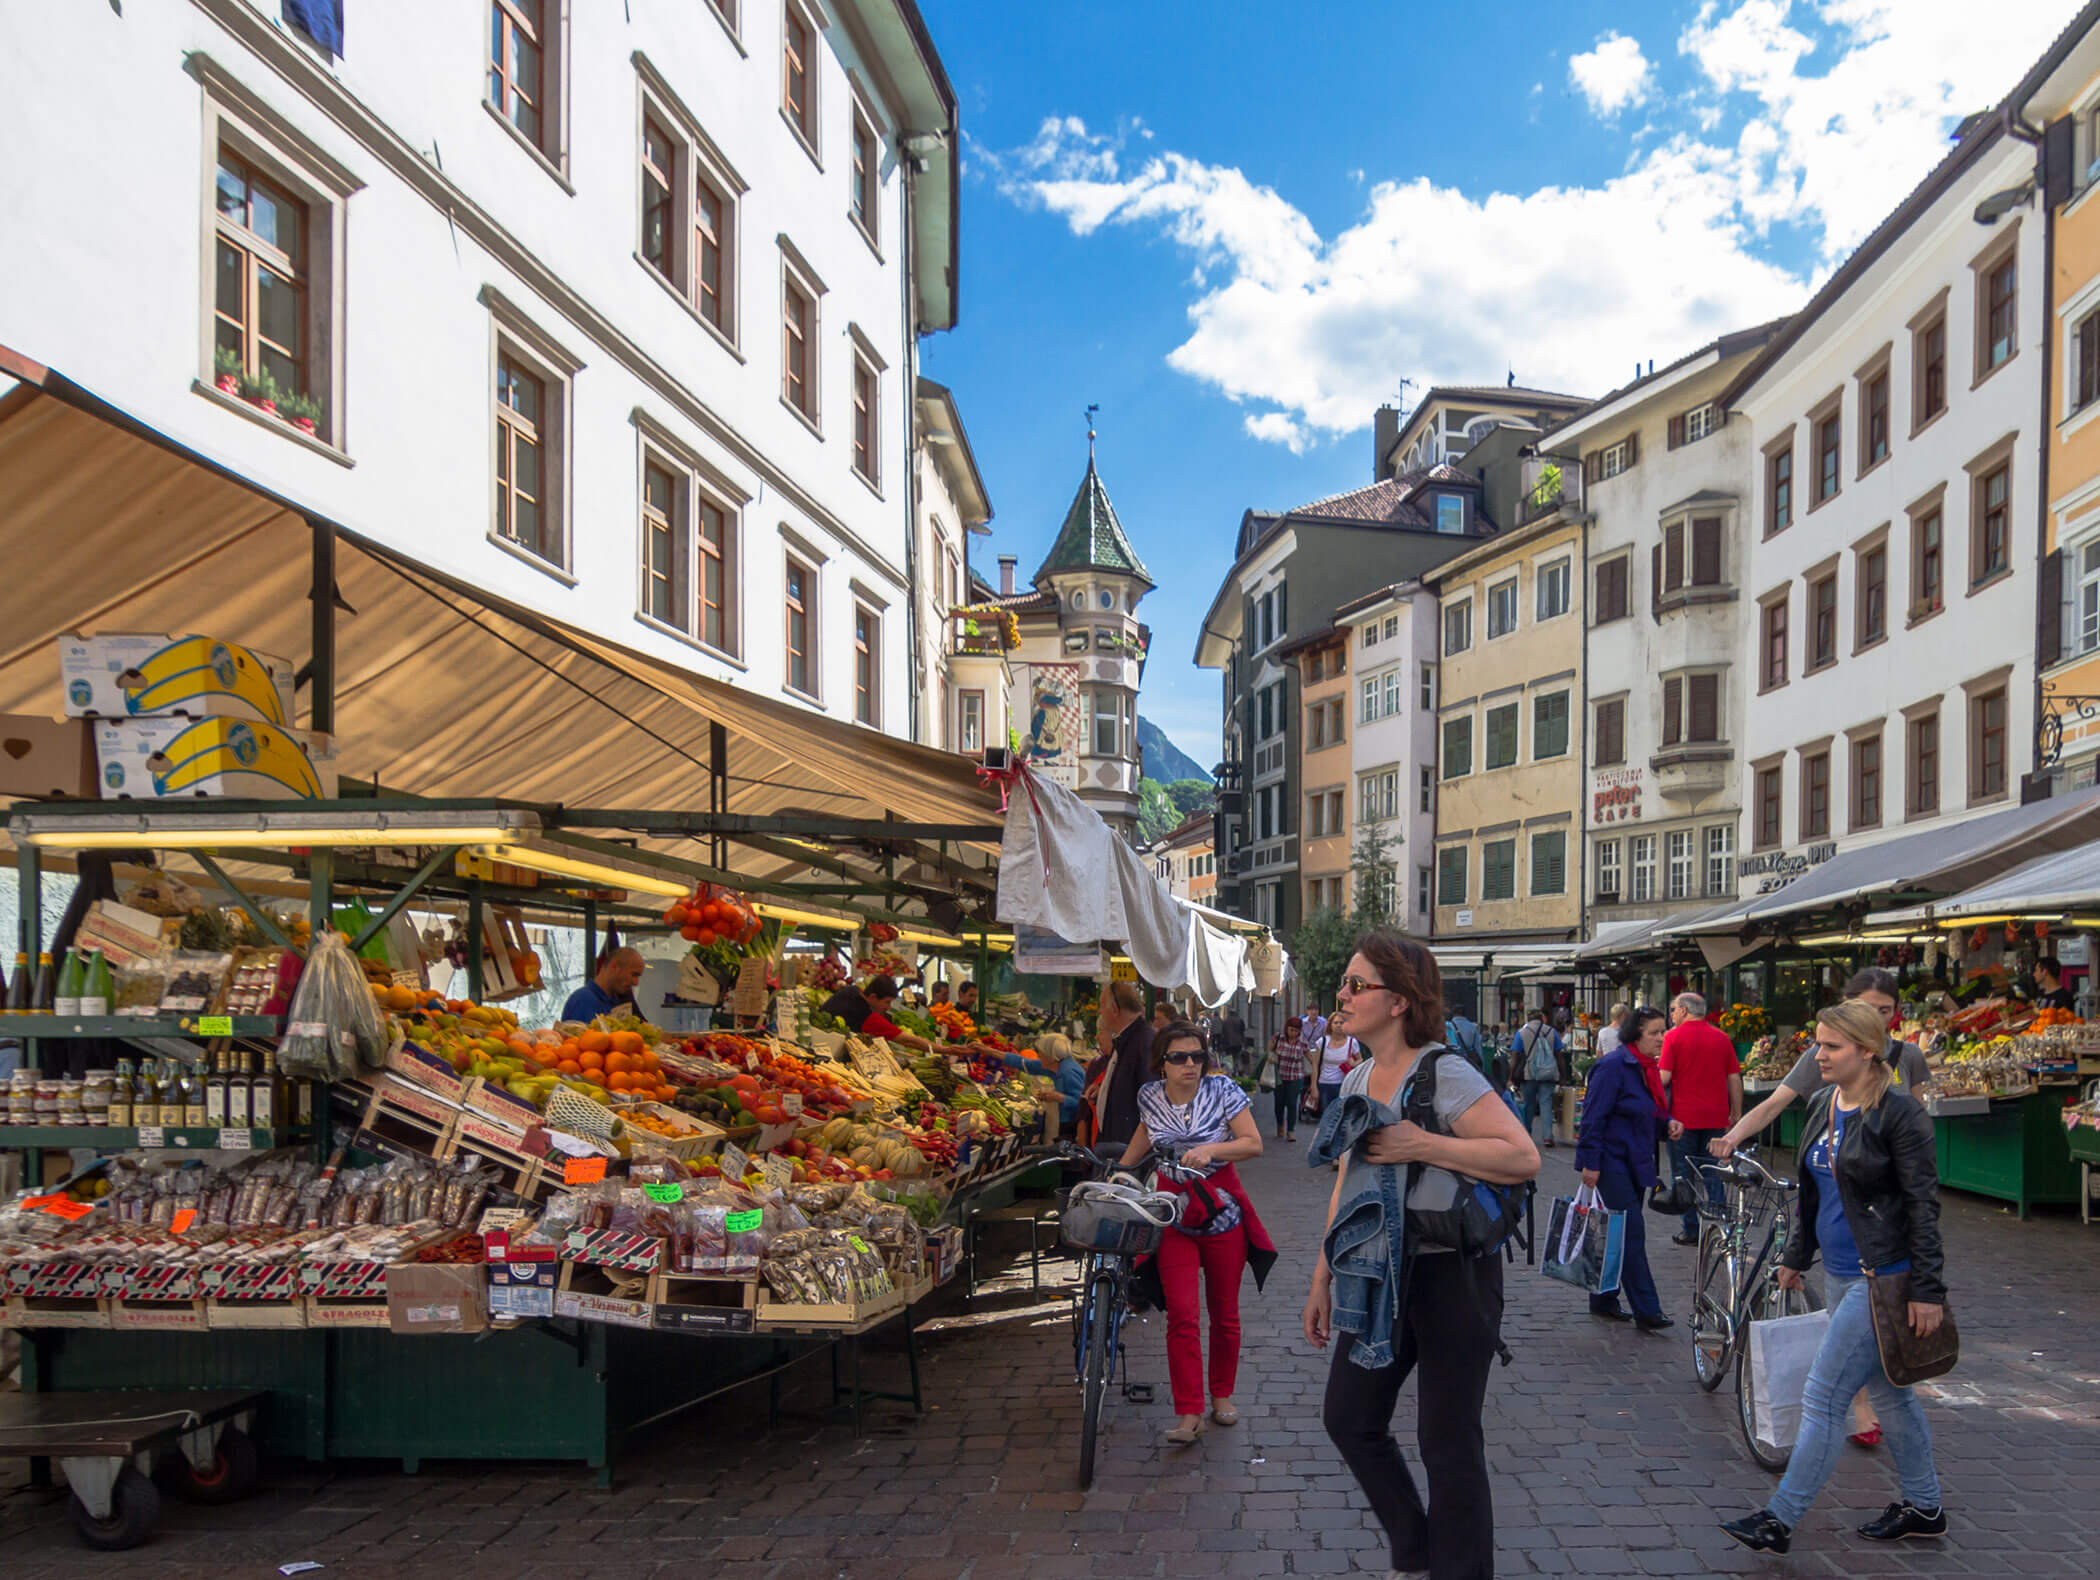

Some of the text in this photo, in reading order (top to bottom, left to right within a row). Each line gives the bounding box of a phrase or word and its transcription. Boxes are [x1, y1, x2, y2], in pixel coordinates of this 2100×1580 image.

[1595, 785, 1642, 811] peter
[1594, 805, 1641, 824] CAFE
[330, 1309, 386, 1321] FRAGOLE
